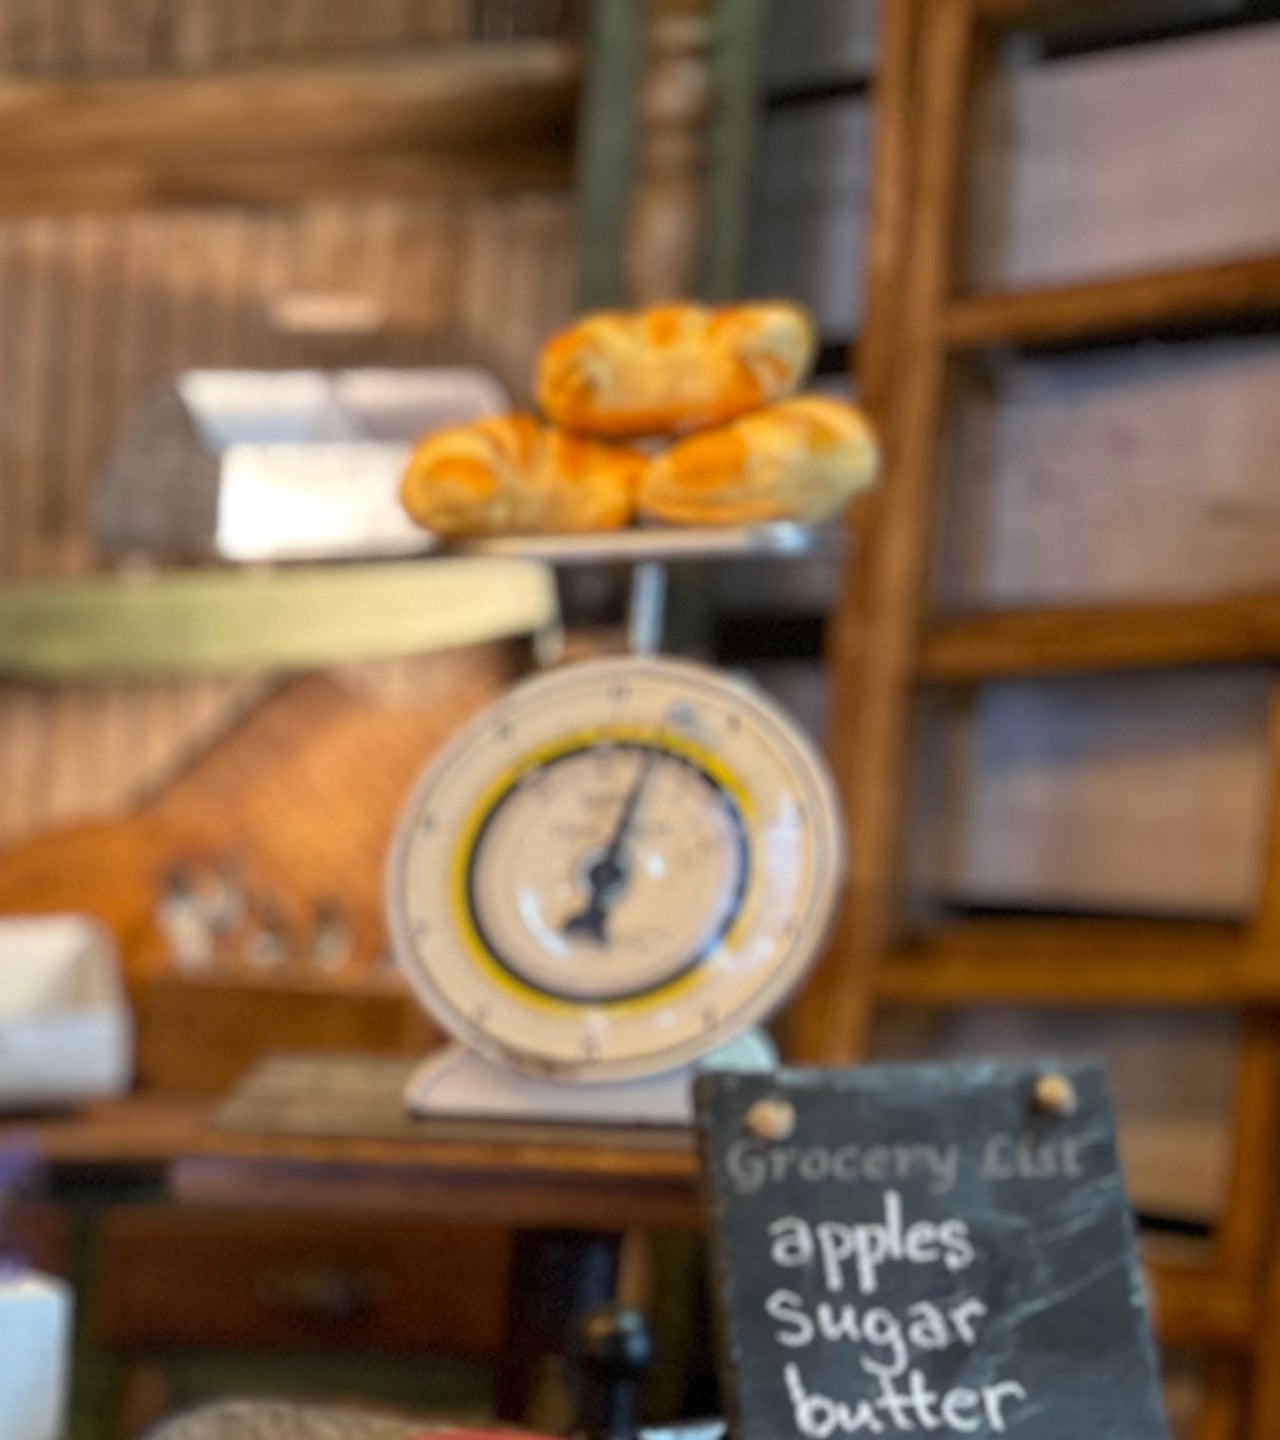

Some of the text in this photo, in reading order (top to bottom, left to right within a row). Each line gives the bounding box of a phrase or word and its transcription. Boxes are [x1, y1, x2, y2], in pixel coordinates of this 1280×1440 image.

[725, 1131, 1087, 1195] Grocery List
[766, 1189, 977, 1294] apples
[783, 1362, 1028, 1440] butter
